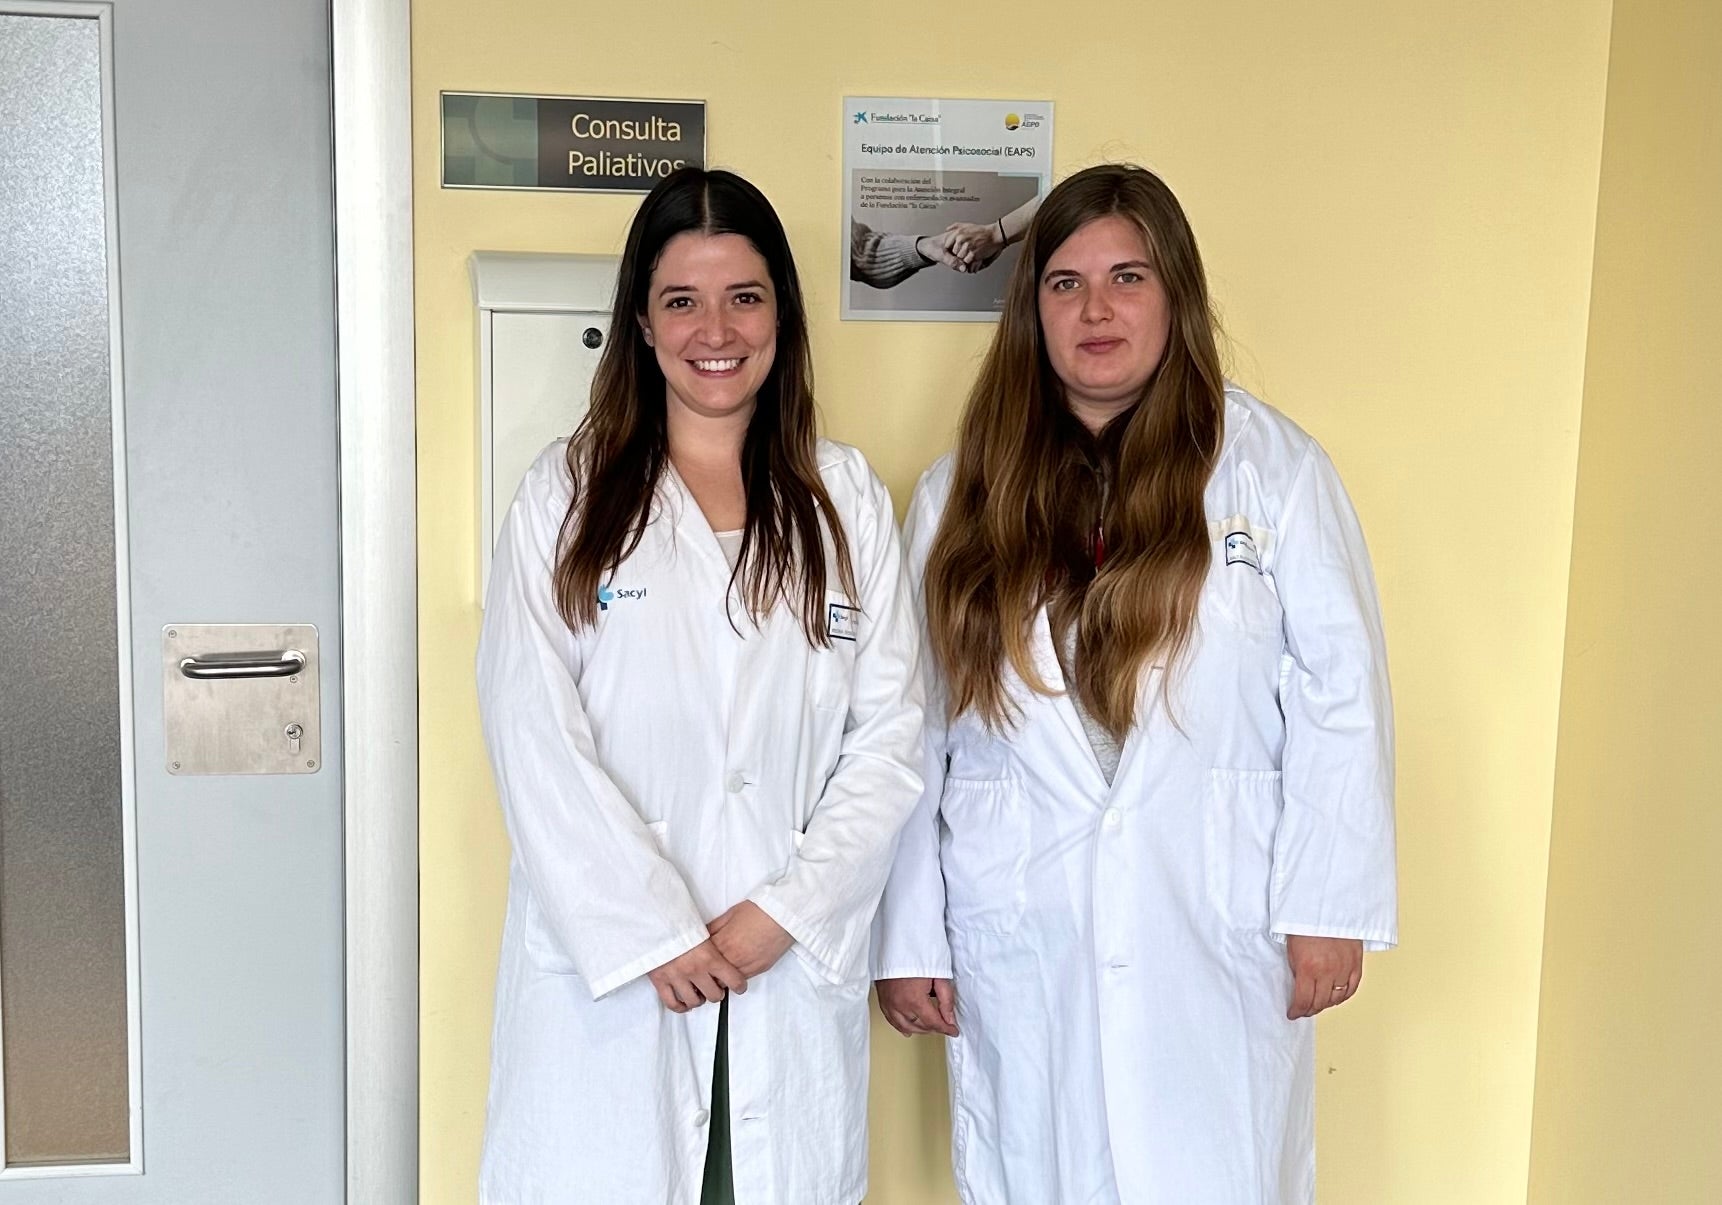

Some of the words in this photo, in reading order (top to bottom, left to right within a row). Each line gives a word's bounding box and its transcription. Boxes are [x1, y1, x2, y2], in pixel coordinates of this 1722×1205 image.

[571, 113, 681, 141] Consulta
[862, 144, 893, 155] Equipo
[895, 144, 907, 154] de
[909, 145, 950, 155] Atención
[953, 146, 1002, 156] Psicosocial
[1004, 146, 1036, 158] (EAPS)
[617, 588, 647, 600] Sacyl
